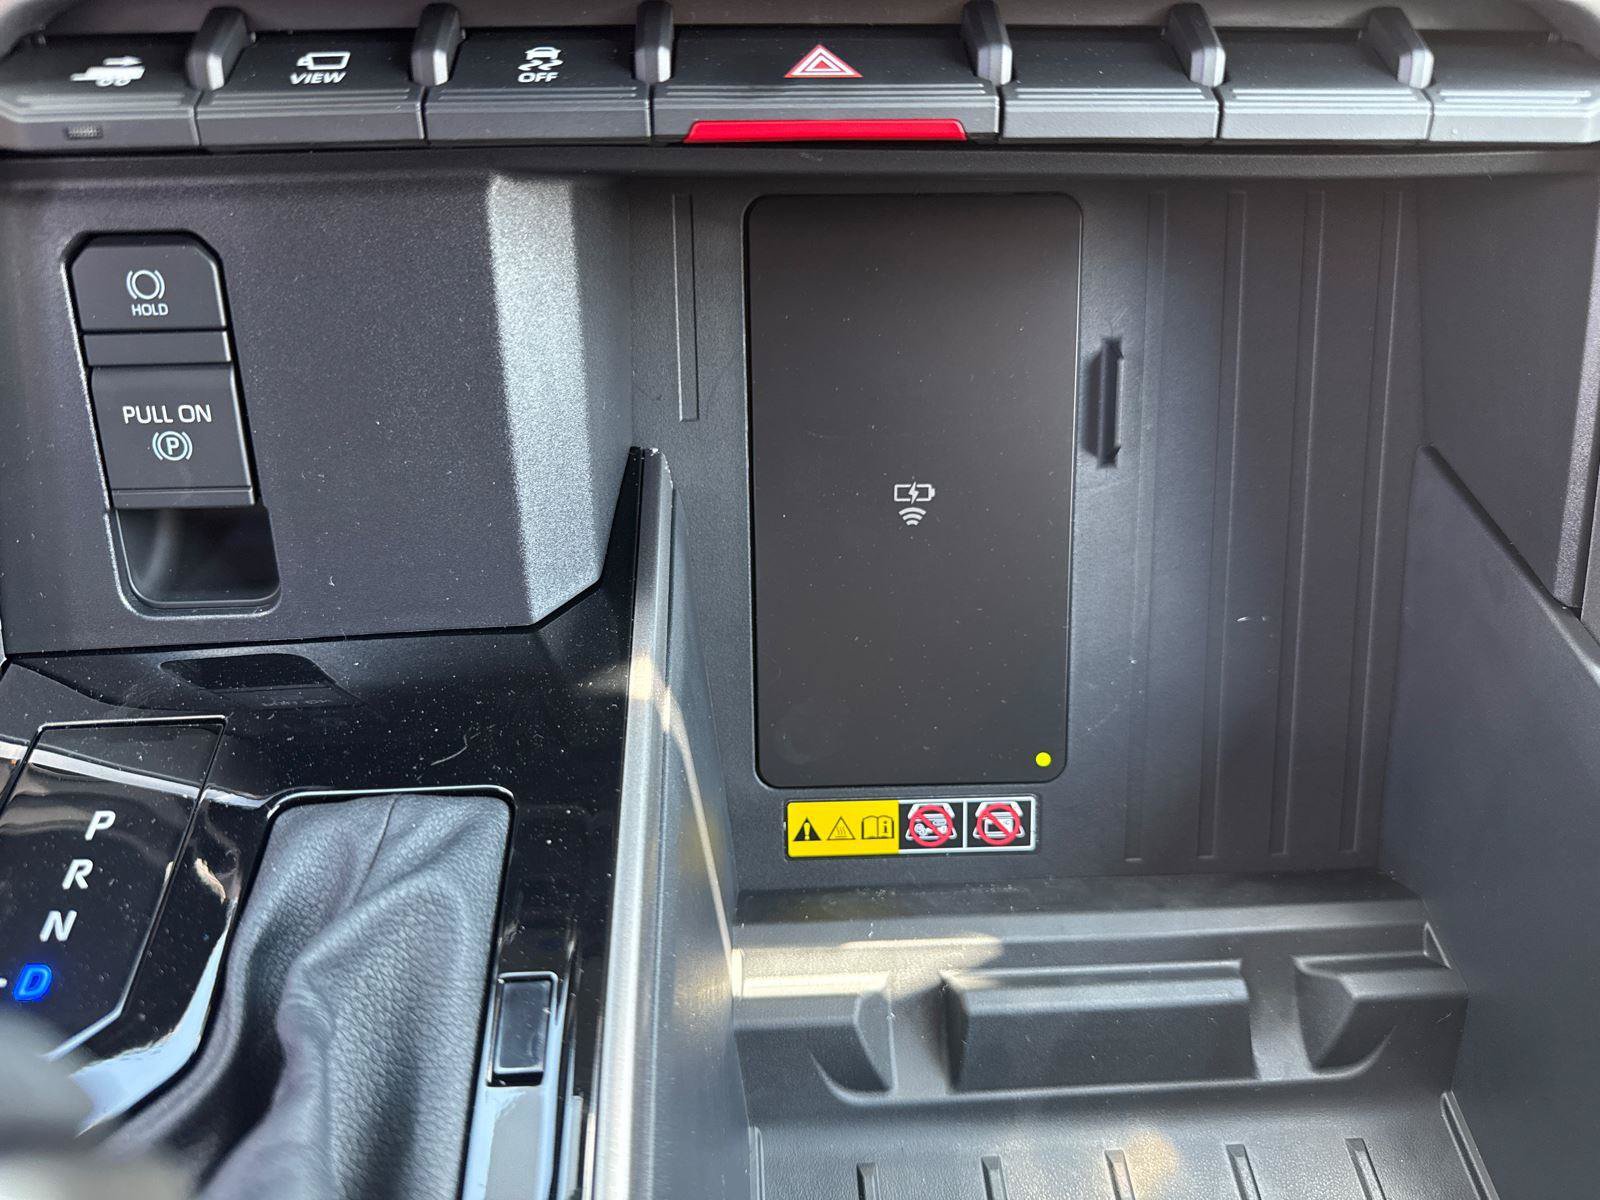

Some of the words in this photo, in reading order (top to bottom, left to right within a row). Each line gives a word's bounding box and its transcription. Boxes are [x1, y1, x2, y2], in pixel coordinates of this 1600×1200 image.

[290, 71, 348, 84] VIEW
[517, 72, 559, 84] OFF
[131, 303, 169, 316] HOLD
[122, 405, 174, 424] PULL
[178, 404, 212, 423] ON
[166, 437, 180, 455] P
[85, 810, 116, 841] P
[62, 859, 94, 890] R
[39, 910, 77, 942] N
[13, 962, 53, 1001] D
